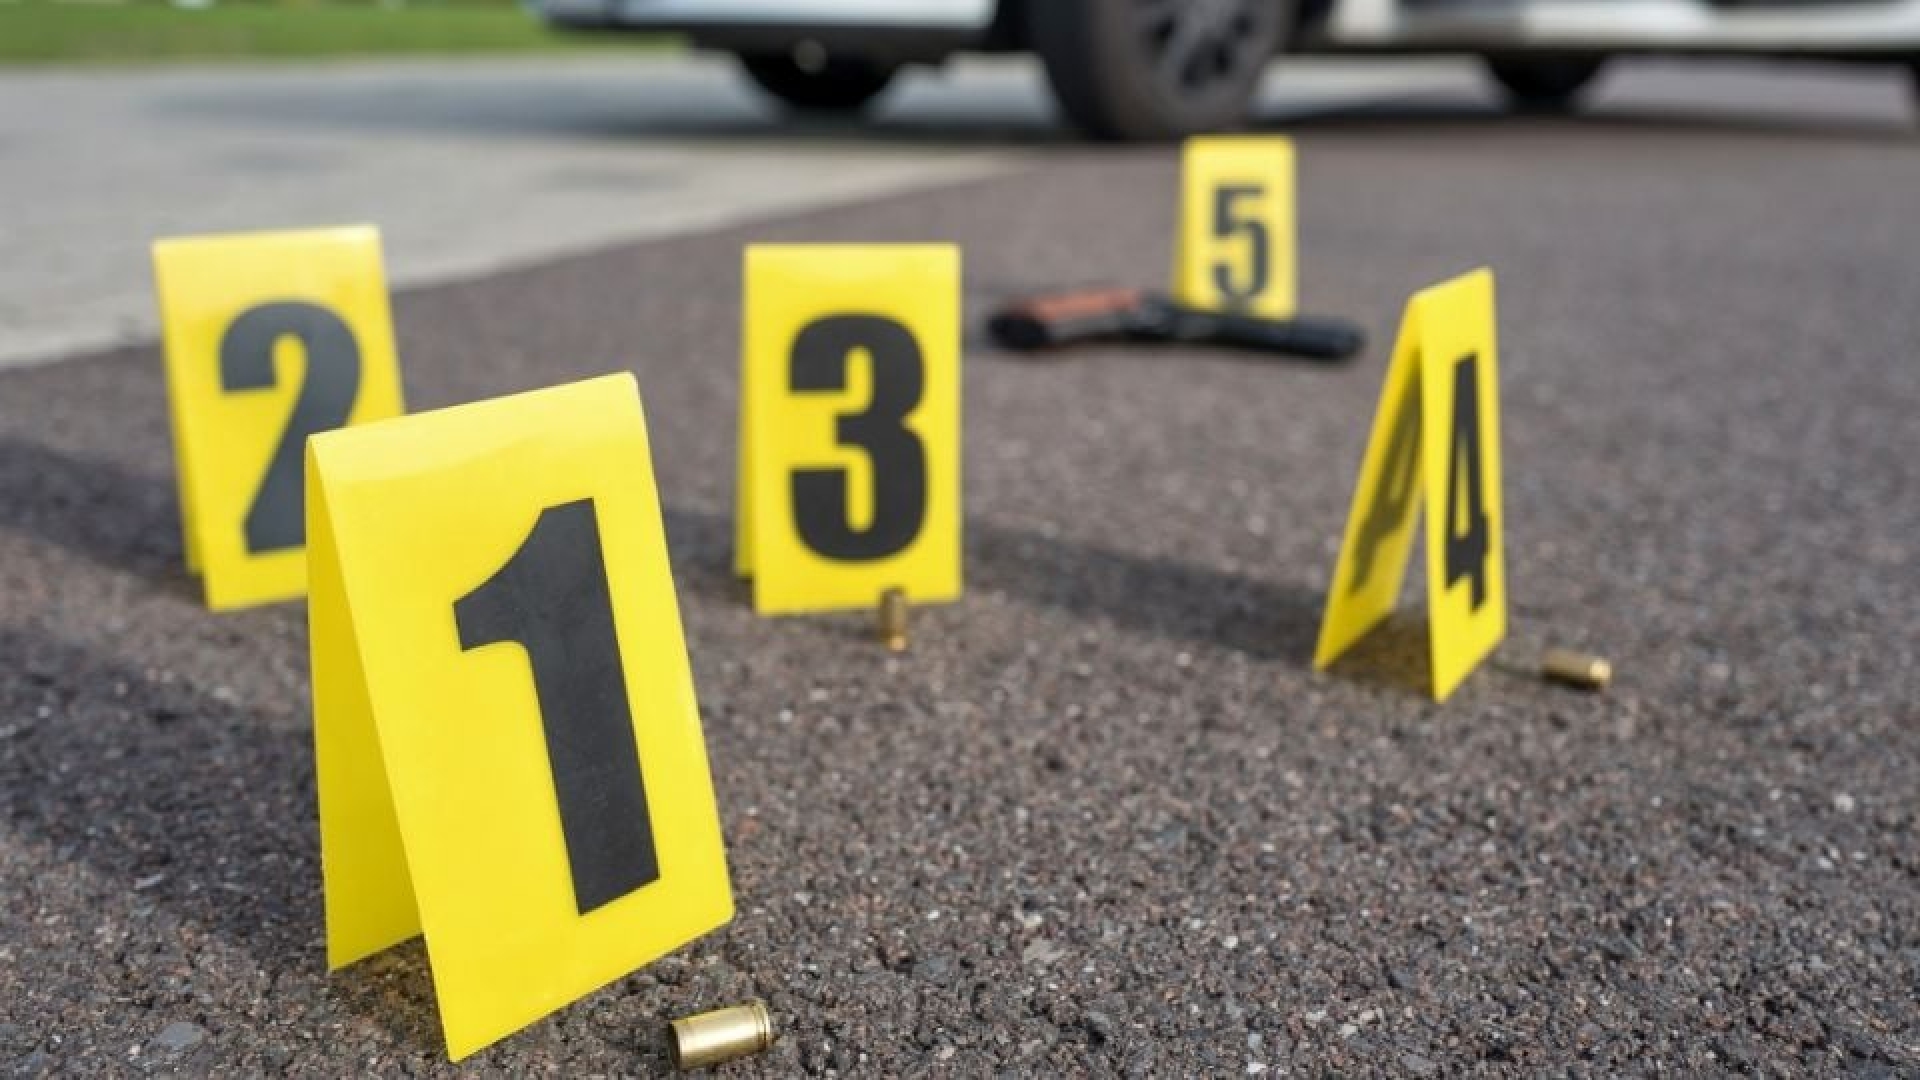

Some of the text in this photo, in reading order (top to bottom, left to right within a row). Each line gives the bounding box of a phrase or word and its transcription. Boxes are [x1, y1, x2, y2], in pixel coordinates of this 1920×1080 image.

[1212, 184, 1271, 303] 5
[219, 301, 361, 556] 2
[787, 312, 928, 563] 3
[1445, 353, 1489, 613] 4
[452, 497, 660, 916] 1
